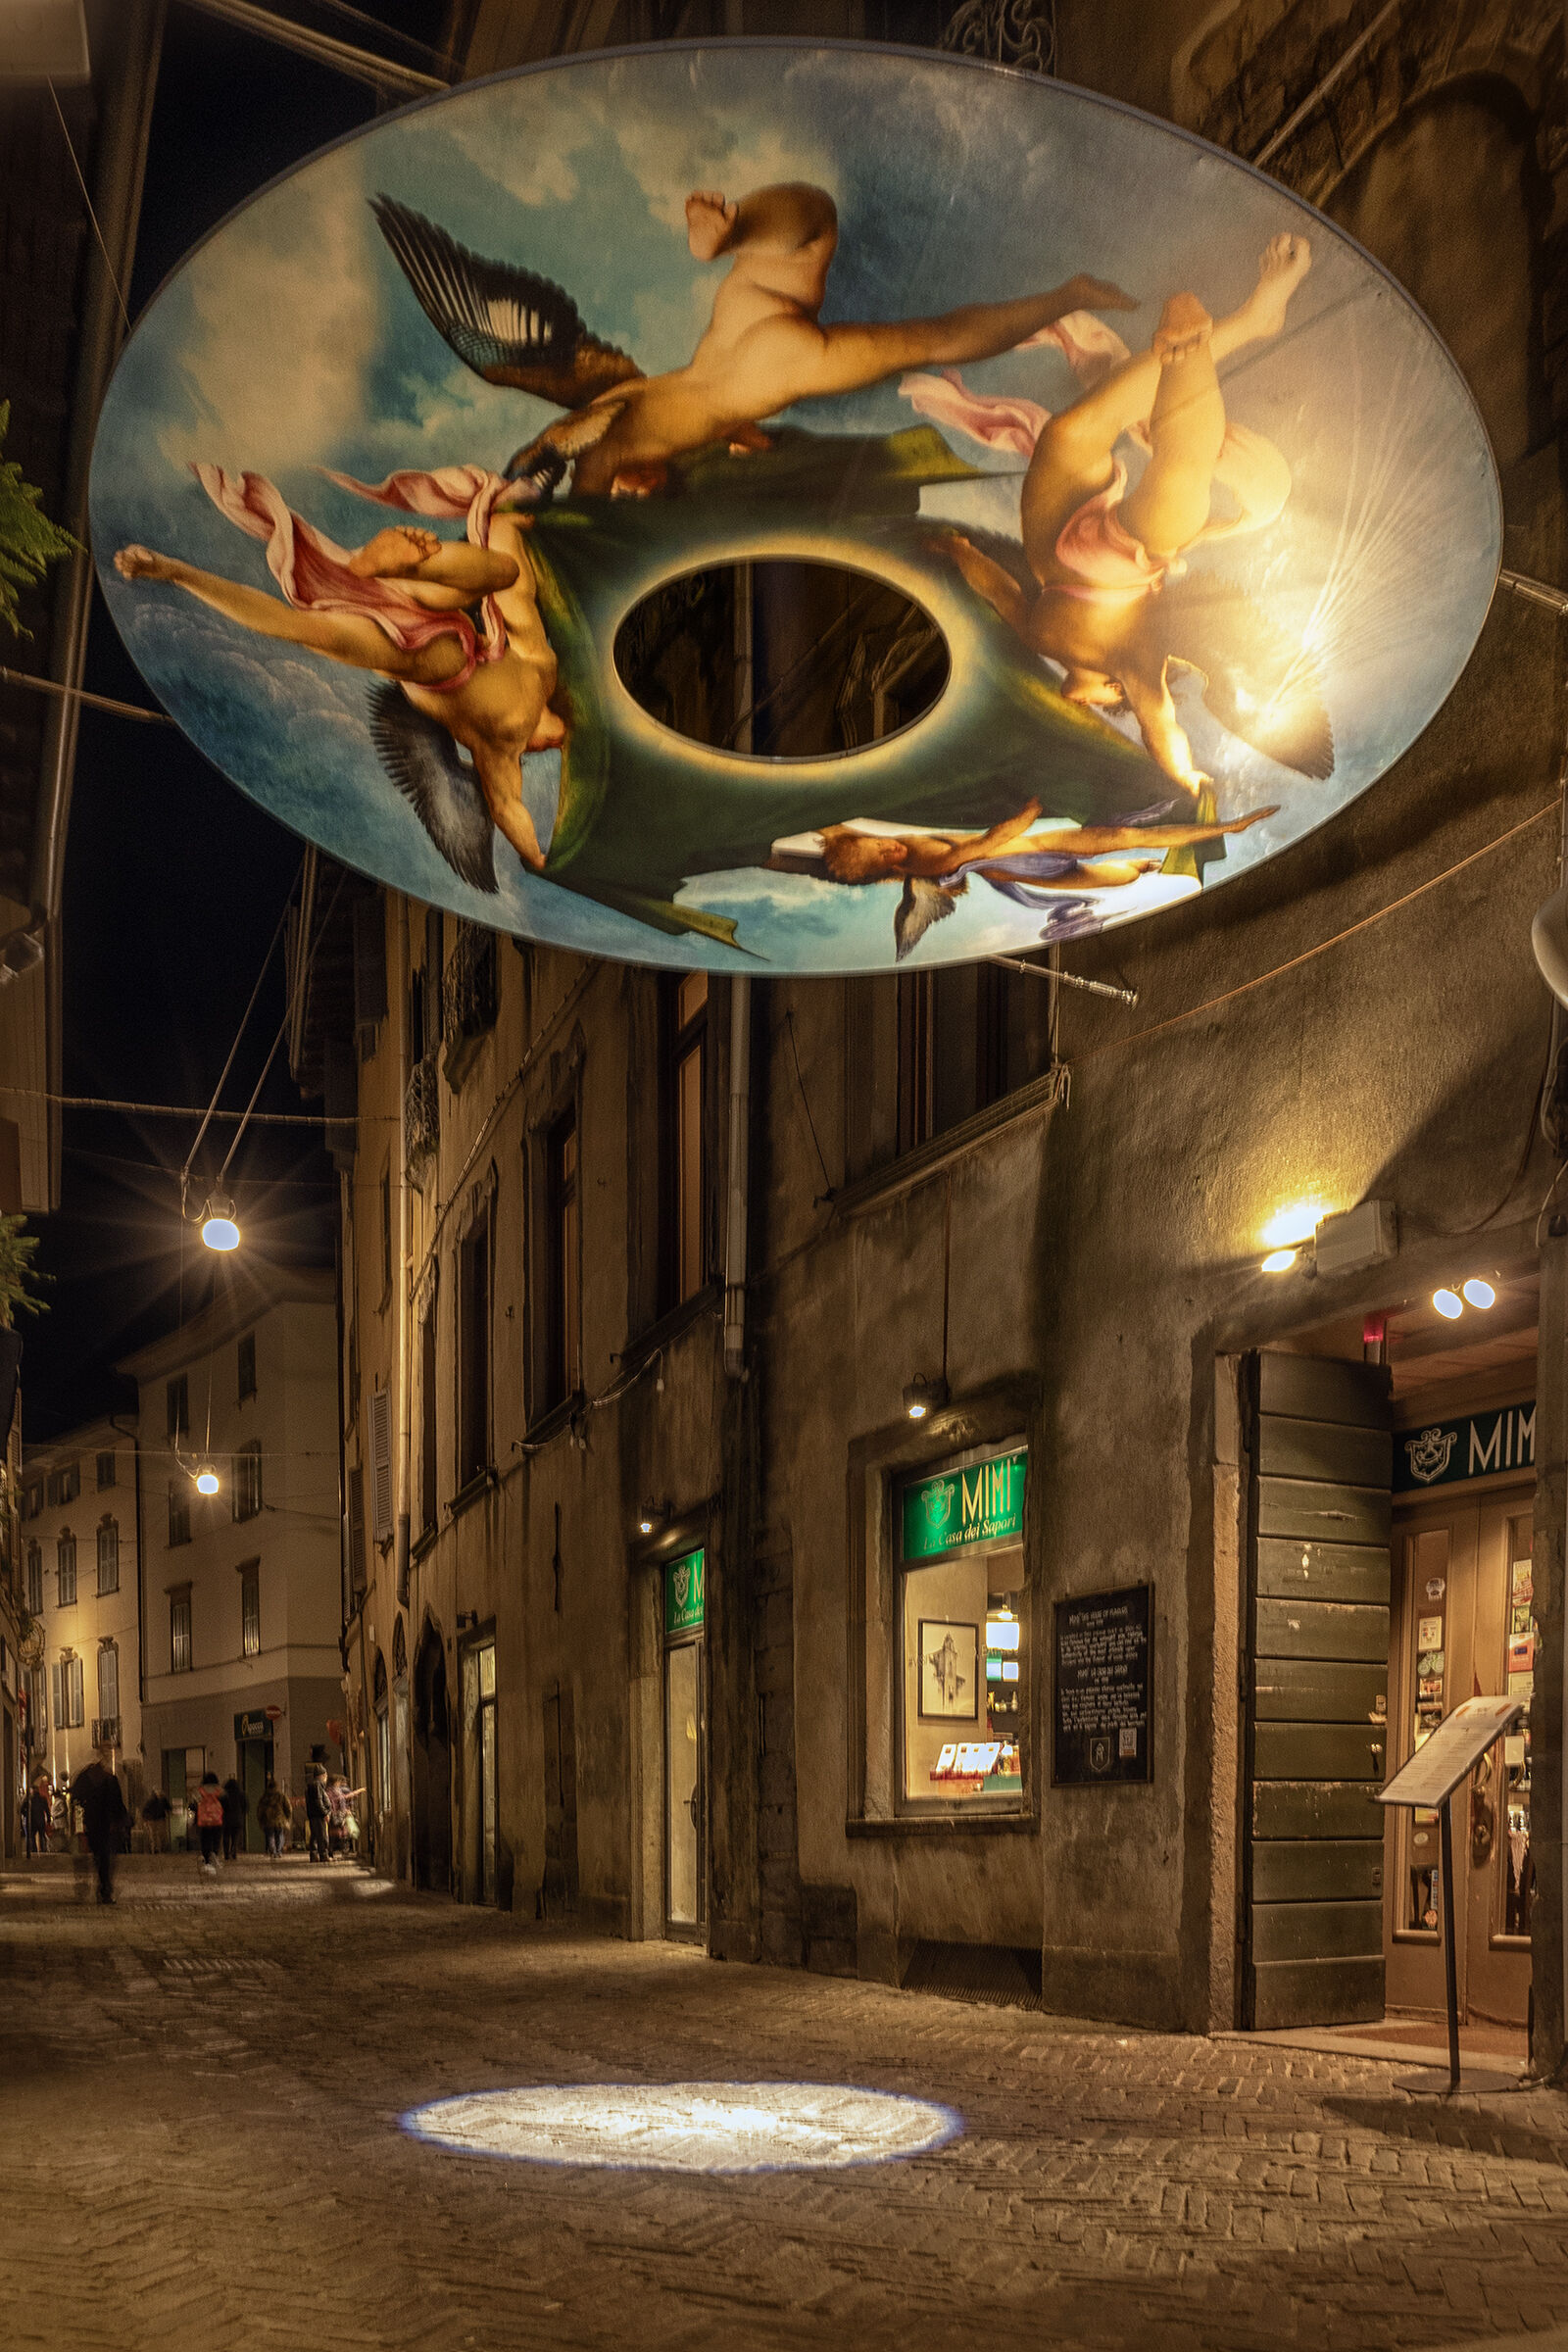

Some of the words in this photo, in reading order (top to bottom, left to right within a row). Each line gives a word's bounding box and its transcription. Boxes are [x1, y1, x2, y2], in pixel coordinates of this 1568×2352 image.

[939, 1531, 962, 1545] Casa
[964, 1523, 980, 1541] dei
[981, 1512, 1016, 1539] Sapori
